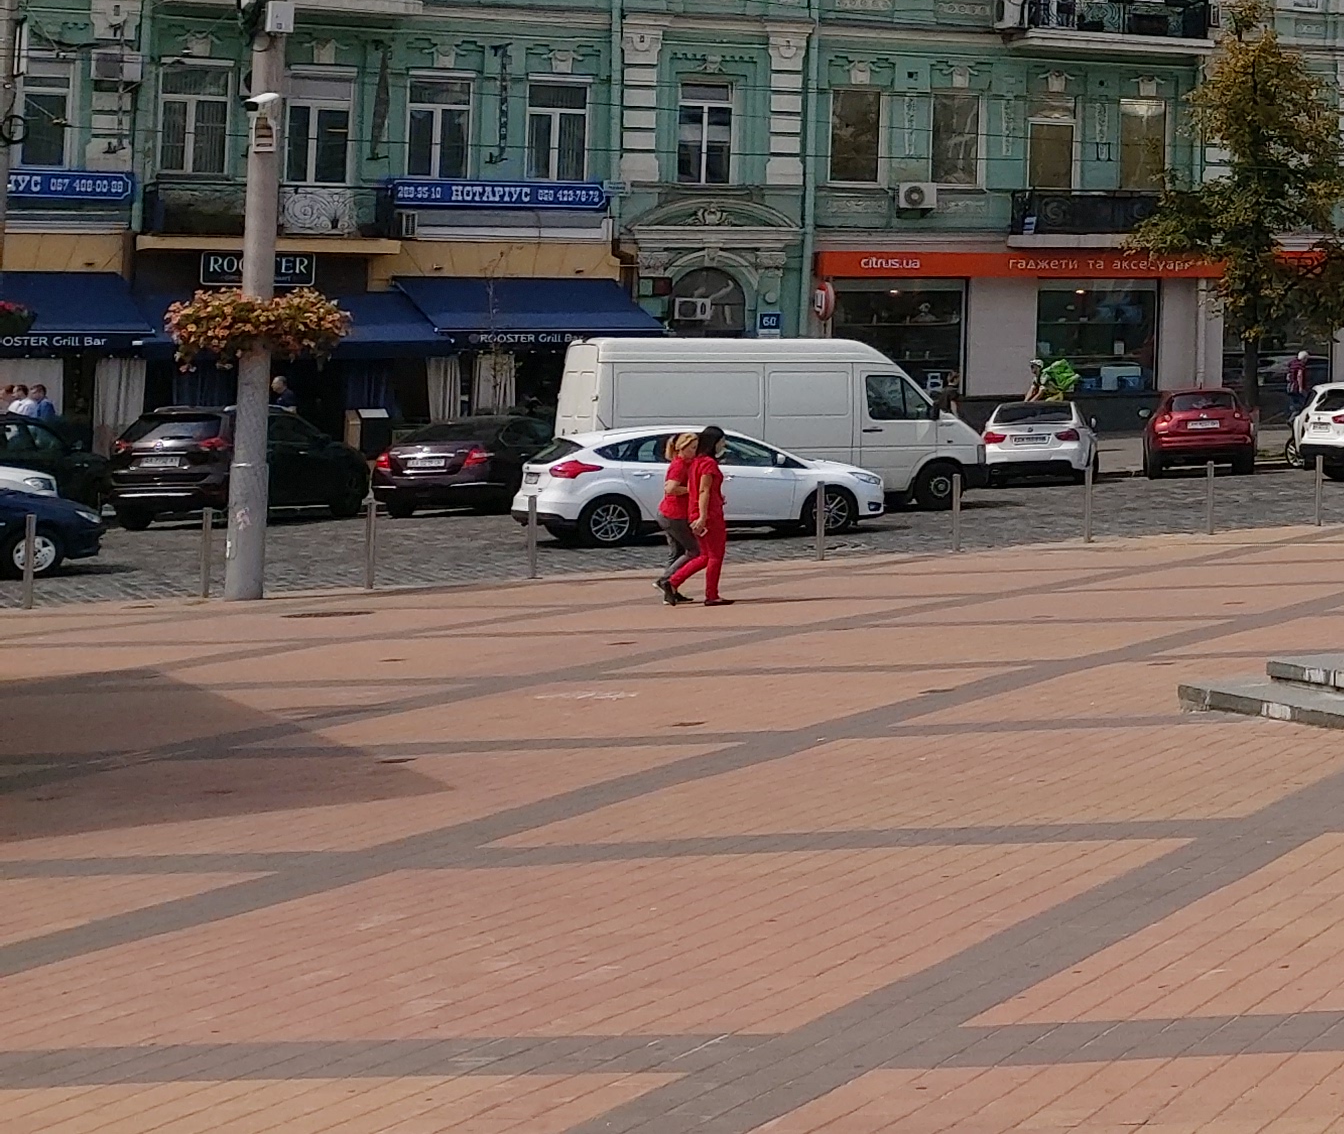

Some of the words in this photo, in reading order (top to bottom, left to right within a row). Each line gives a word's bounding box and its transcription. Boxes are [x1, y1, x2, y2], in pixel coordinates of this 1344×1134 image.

[451, 185, 531, 202] НОТАРІУС
[209, 255, 308, 274] ROER
[860, 257, 920, 269] citrus.ua
[1009, 258, 1078, 270] гаджети
[1087, 260, 1104, 270] та
[1112, 259, 1190, 272] аксесуар
[762, 316, 777, 326] 60
[0, 336, 48, 346] OSTER
[52, 336, 80, 346] Grill
[84, 336, 108, 346] Bar
[538, 333, 561, 343] Grill
